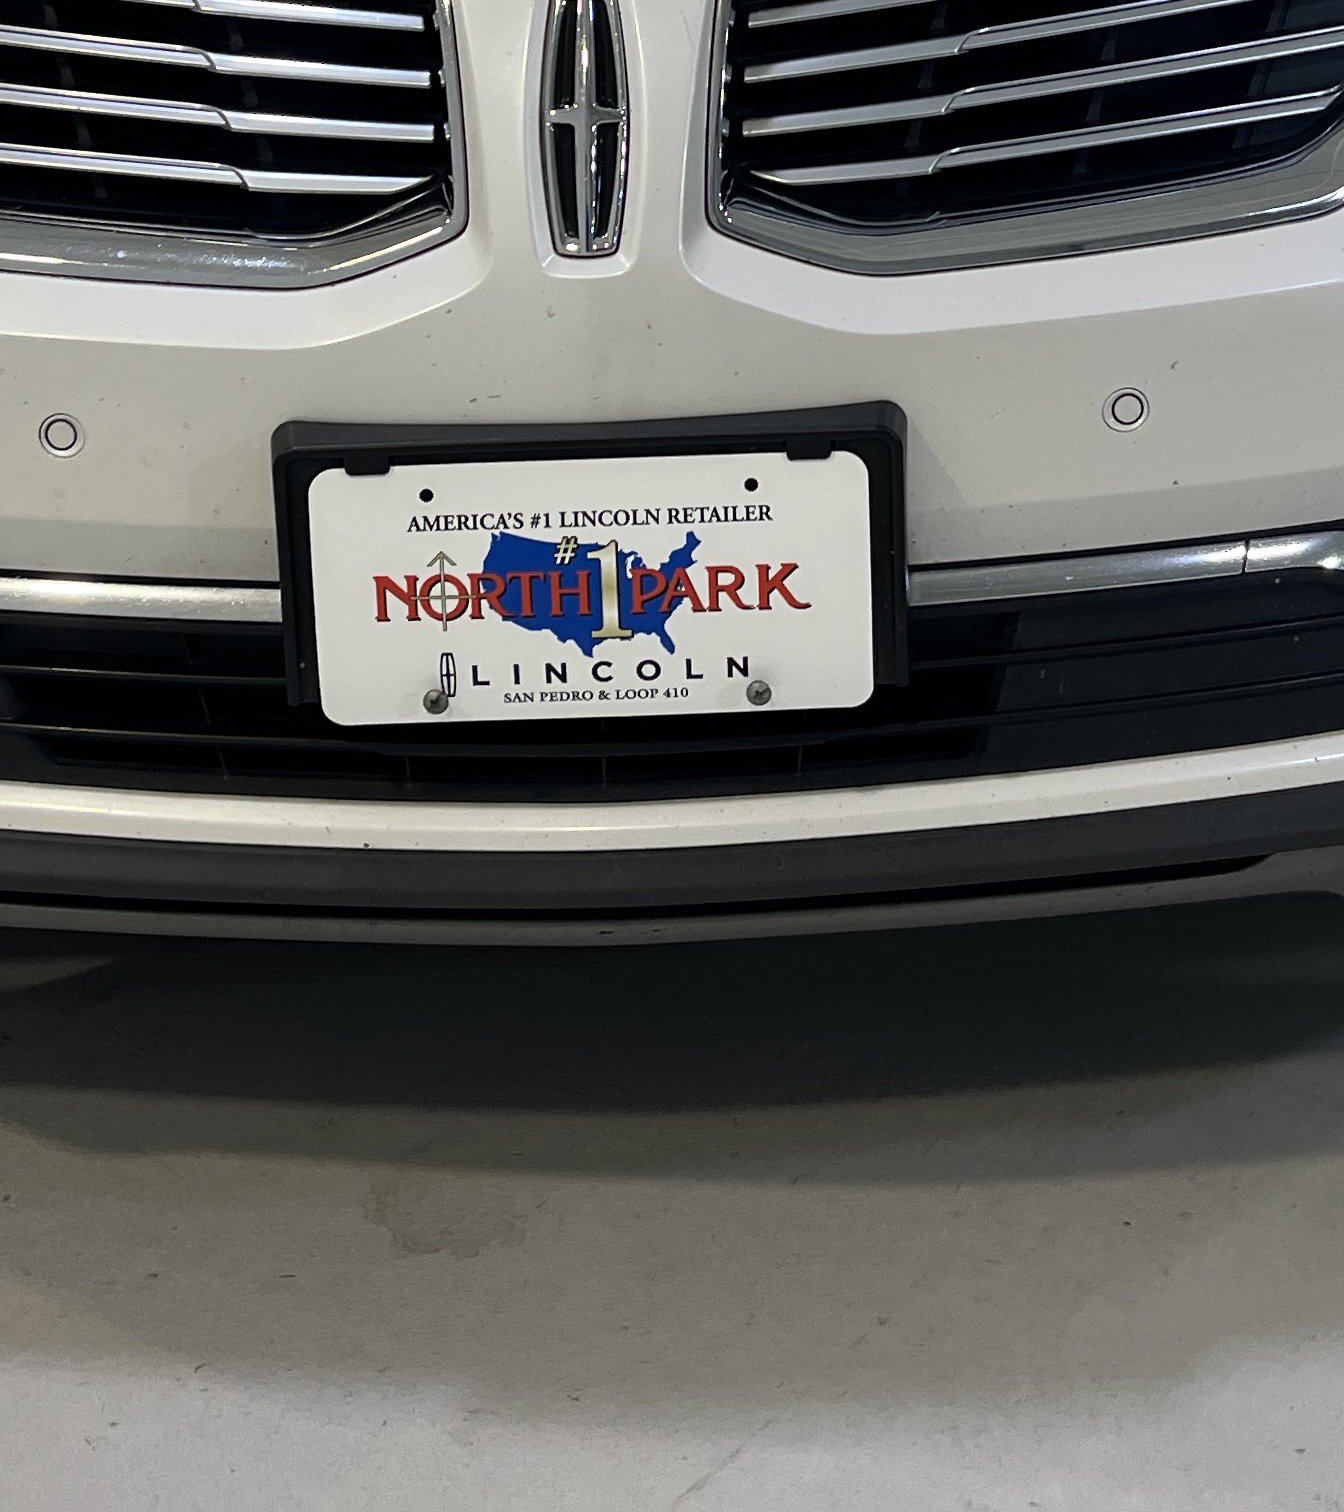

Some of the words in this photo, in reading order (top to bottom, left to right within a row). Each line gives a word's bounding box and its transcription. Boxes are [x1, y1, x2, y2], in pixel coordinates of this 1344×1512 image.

[407, 512, 524, 533] AMERICA'S
[530, 512, 552, 529] #1
[559, 508, 661, 528] LINCOLN
[666, 504, 773, 525] RETAILER
[373, 568, 592, 622] NORTH
[629, 562, 812, 616] PARK
[471, 656, 749, 687] LINCOLN
[503, 691, 535, 704] SAN
[539, 690, 594, 703] PEDRO
[598, 689, 610, 701] &
[616, 688, 659, 701] LOOP
[663, 687, 689, 698] 410
